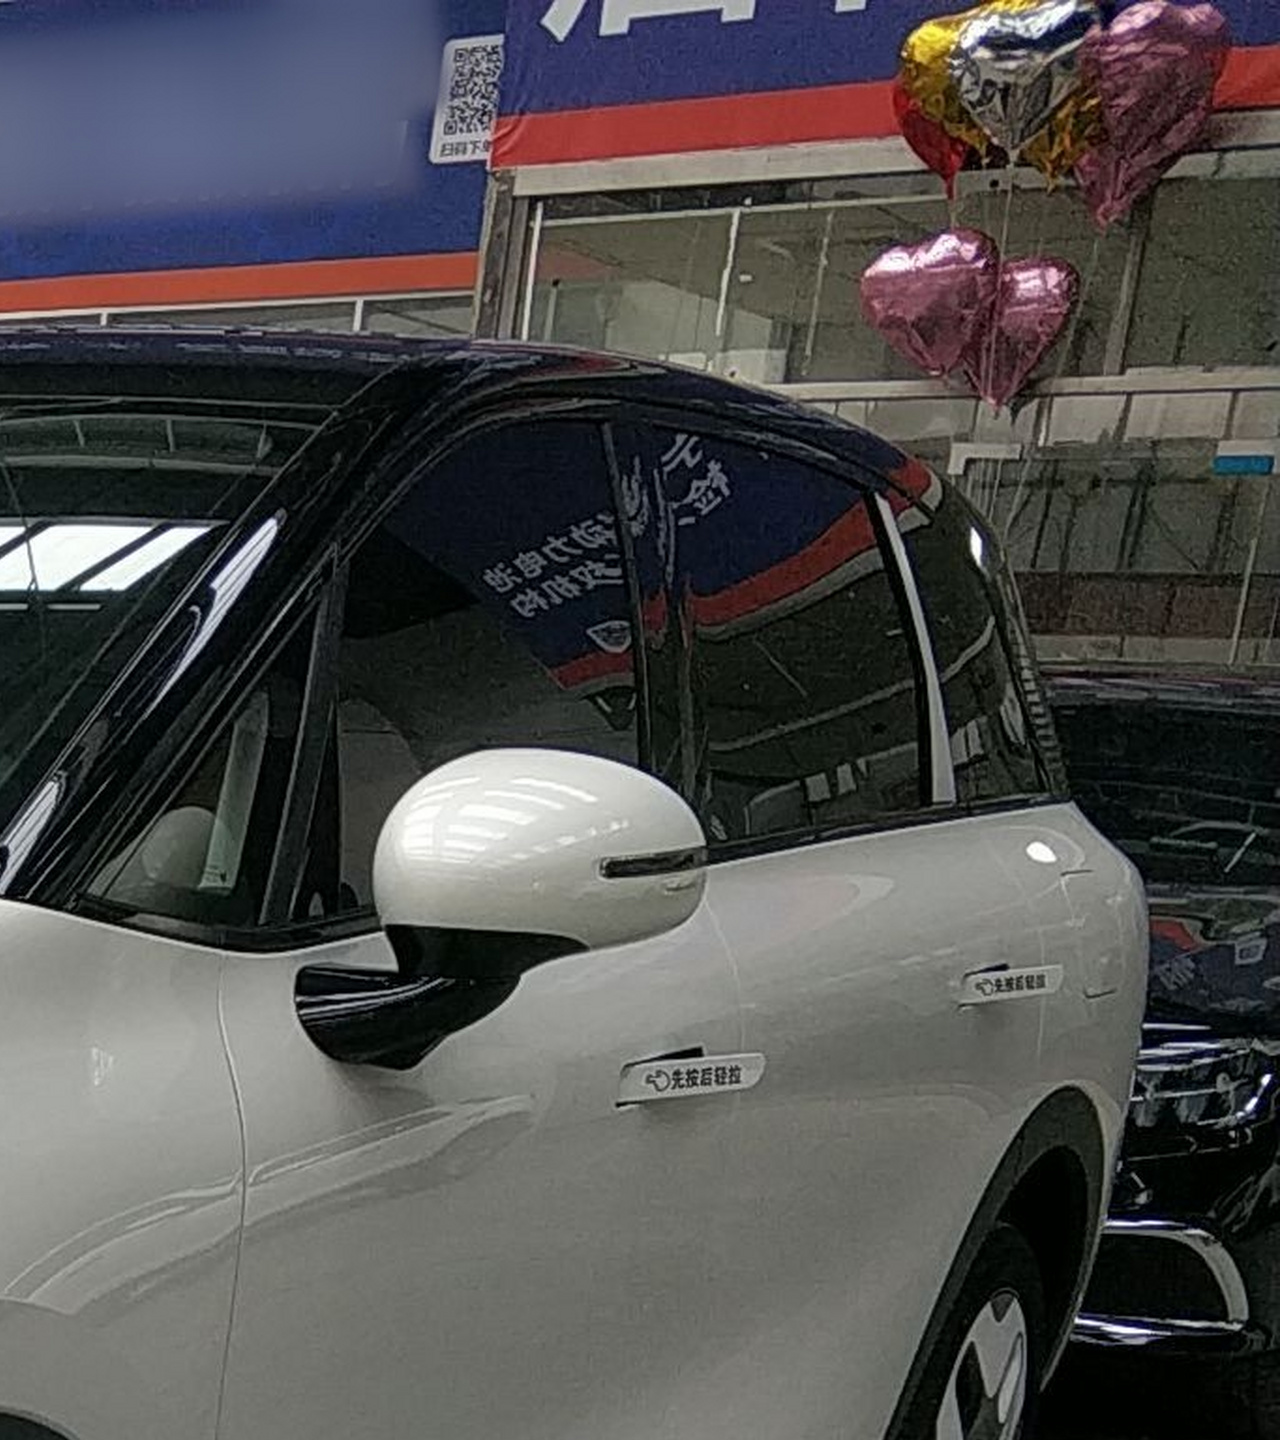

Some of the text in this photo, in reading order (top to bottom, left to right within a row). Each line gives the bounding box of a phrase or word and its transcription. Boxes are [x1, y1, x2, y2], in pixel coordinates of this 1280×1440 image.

[671, 1064, 742, 1090] 先按后轻拉
